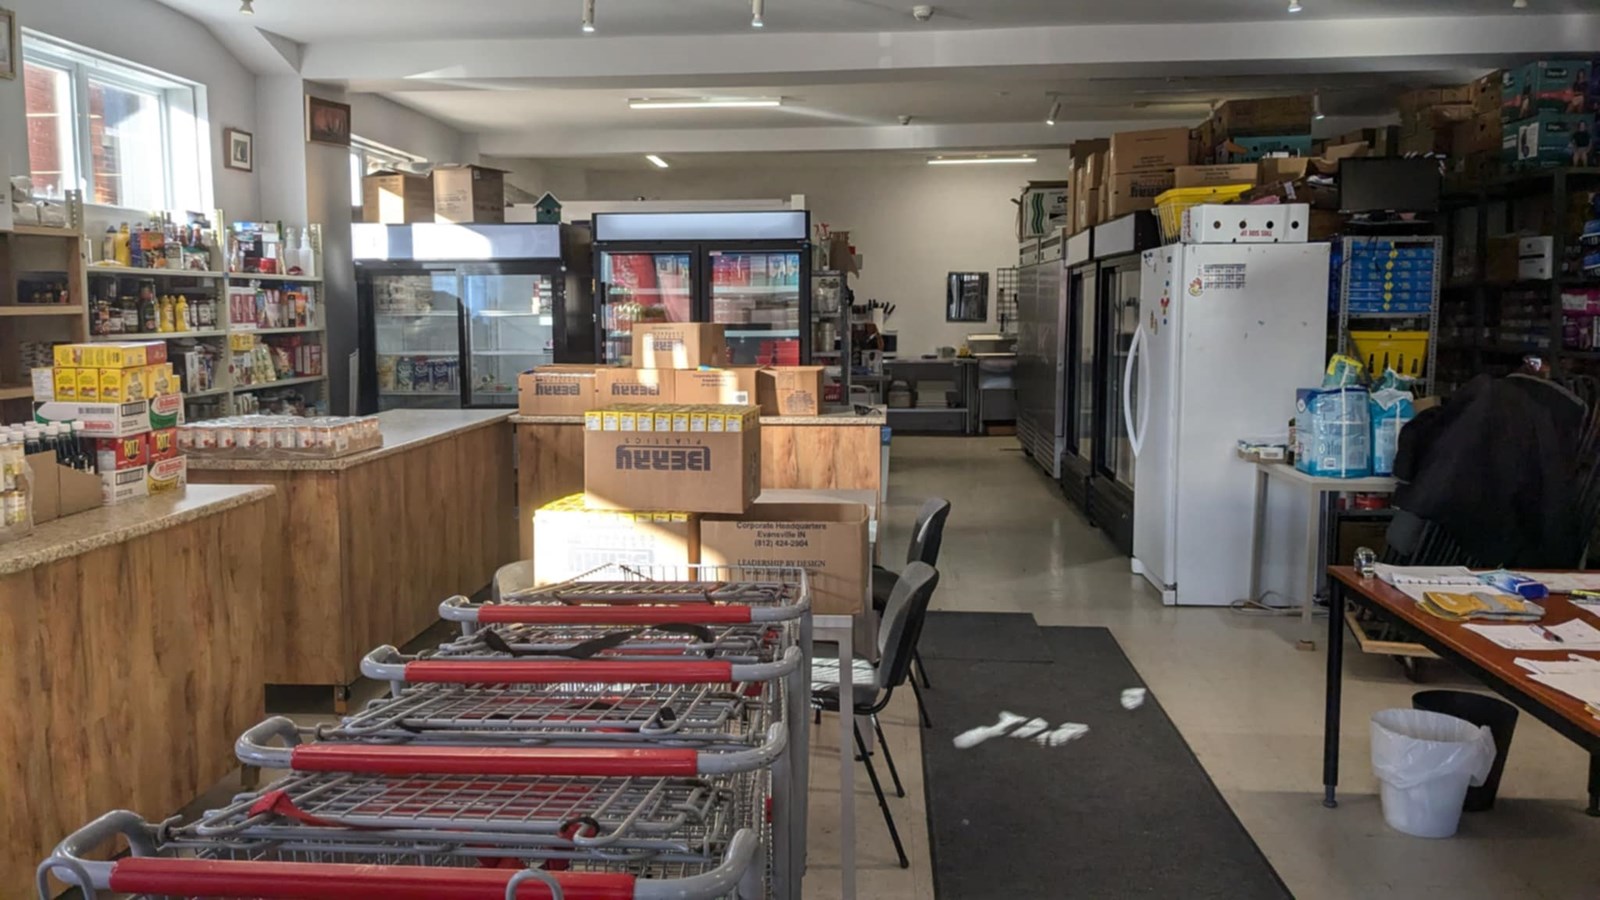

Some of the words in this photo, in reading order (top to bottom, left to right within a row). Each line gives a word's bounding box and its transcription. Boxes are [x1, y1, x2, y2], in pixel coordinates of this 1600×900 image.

[535, 383, 579, 395] BERRY
[124, 440, 140, 458] RITZ
[616, 445, 711, 471] BERRY
[738, 559, 784, 567] LEADERSHIP
